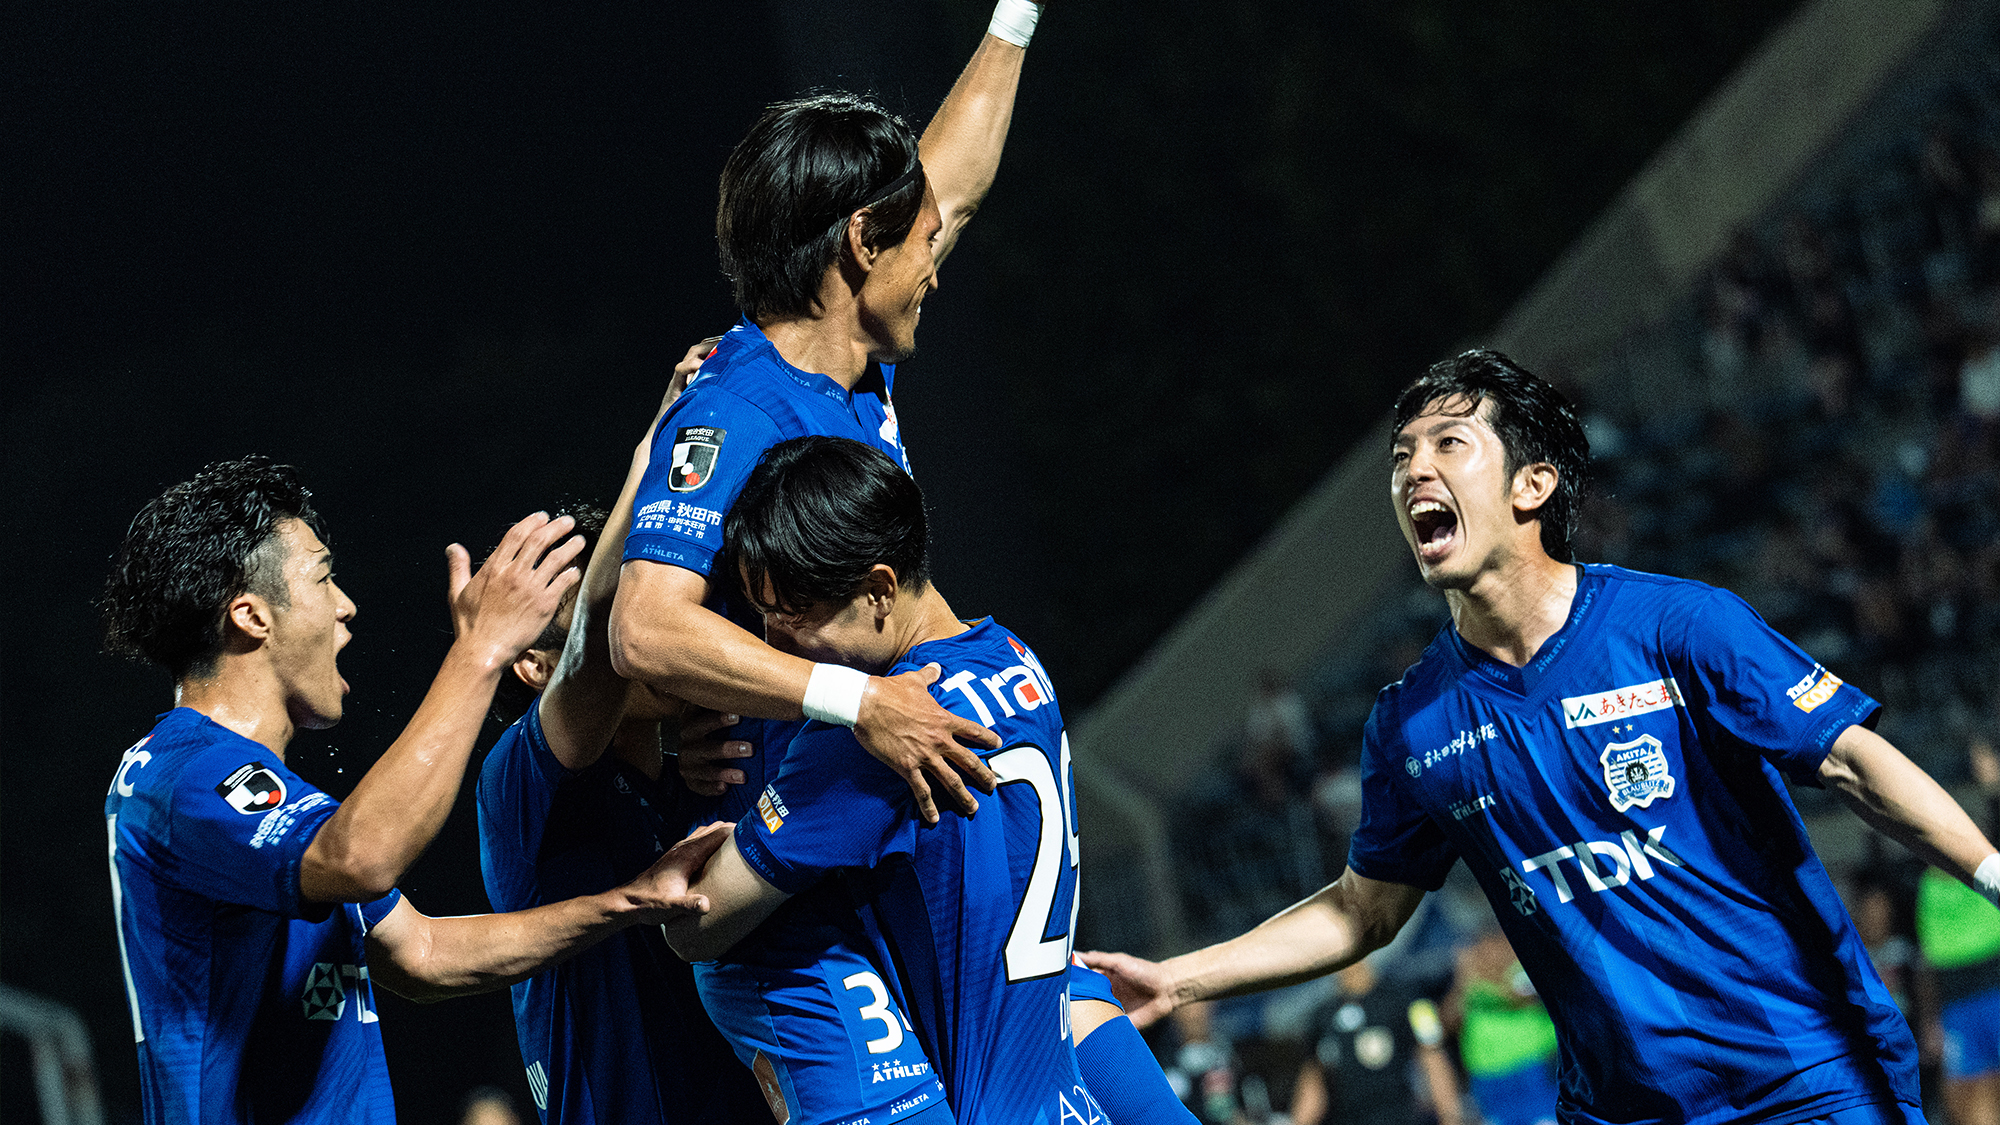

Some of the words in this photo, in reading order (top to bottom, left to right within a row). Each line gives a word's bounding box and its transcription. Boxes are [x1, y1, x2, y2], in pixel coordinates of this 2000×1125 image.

[641, 547, 684, 562] ATHLETA
[1572, 587, 1597, 625] ATHLETA
[1537, 637, 1567, 673] ATHLETA
[1478, 661, 1509, 682] ATHLETA
[1616, 747, 1648, 763] AKITA
[1521, 824, 1687, 904] TDK
[872, 1062, 929, 1084] ATHLET
[890, 1093, 930, 1116] ATHLETA
